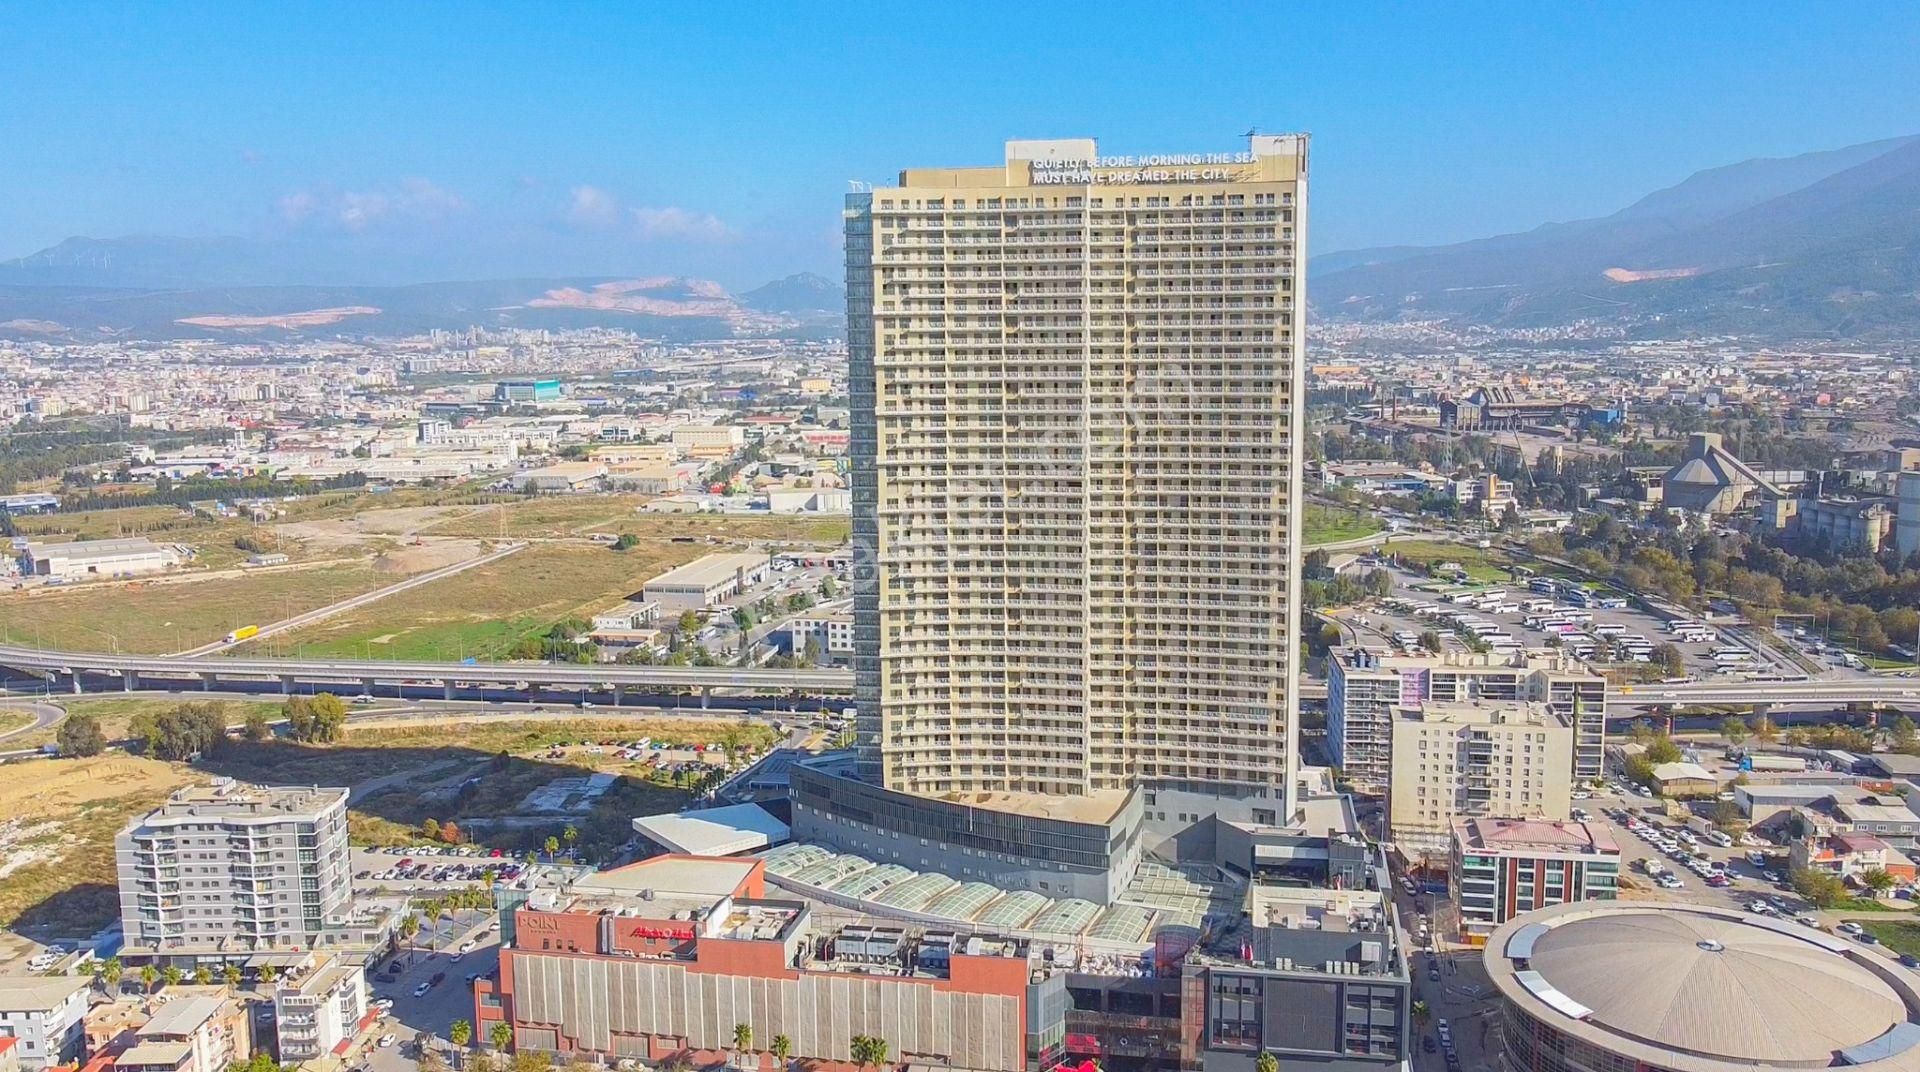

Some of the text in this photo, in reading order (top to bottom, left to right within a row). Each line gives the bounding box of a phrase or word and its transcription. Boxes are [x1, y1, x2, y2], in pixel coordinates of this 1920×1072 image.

[1087, 156, 1132, 168] BEFORE
[1207, 153, 1230, 164] THE
[1235, 152, 1259, 163] SEA
[1033, 168, 1229, 184] MUST HAVE DREAMED THE CITY
